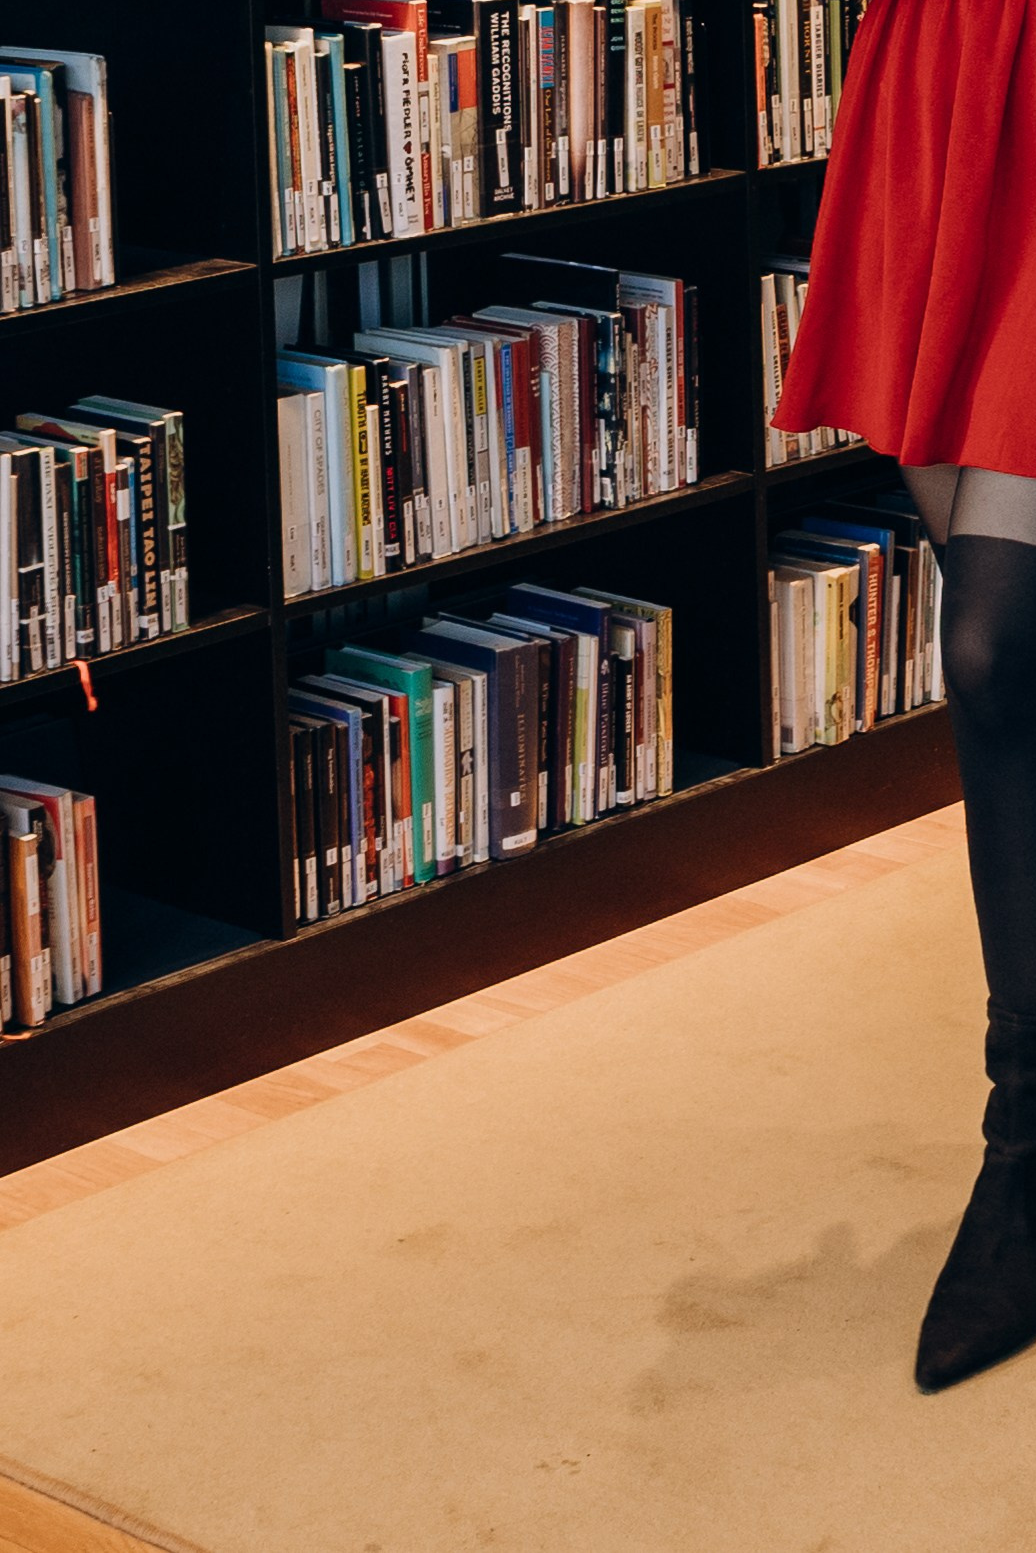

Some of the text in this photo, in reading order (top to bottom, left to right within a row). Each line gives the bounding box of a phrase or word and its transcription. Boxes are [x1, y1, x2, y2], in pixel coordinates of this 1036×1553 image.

[417, 8, 427, 82] Life Undercover
[490, 12, 501, 115] WILLIAM GADDIS
[501, 11, 512, 132] THE RECOGNITIONS
[816, 63, 824, 99] DIARIES
[405, 157, 415, 203] ÖMHET
[421, 153, 430, 194] Amaryllis
[357, 389, 367, 427] TLOOTH
[381, 374, 392, 456] HARRY MATHEWS
[313, 409, 325, 496] CITY OF SPADES
[385, 466, 394, 492] MITT
[139, 443, 157, 607] TAIPEI TAO LIN
[868, 572, 878, 626] HUNTER
[864, 641, 877, 711] THOMPSON
[601, 712, 609, 765] Pastoral
